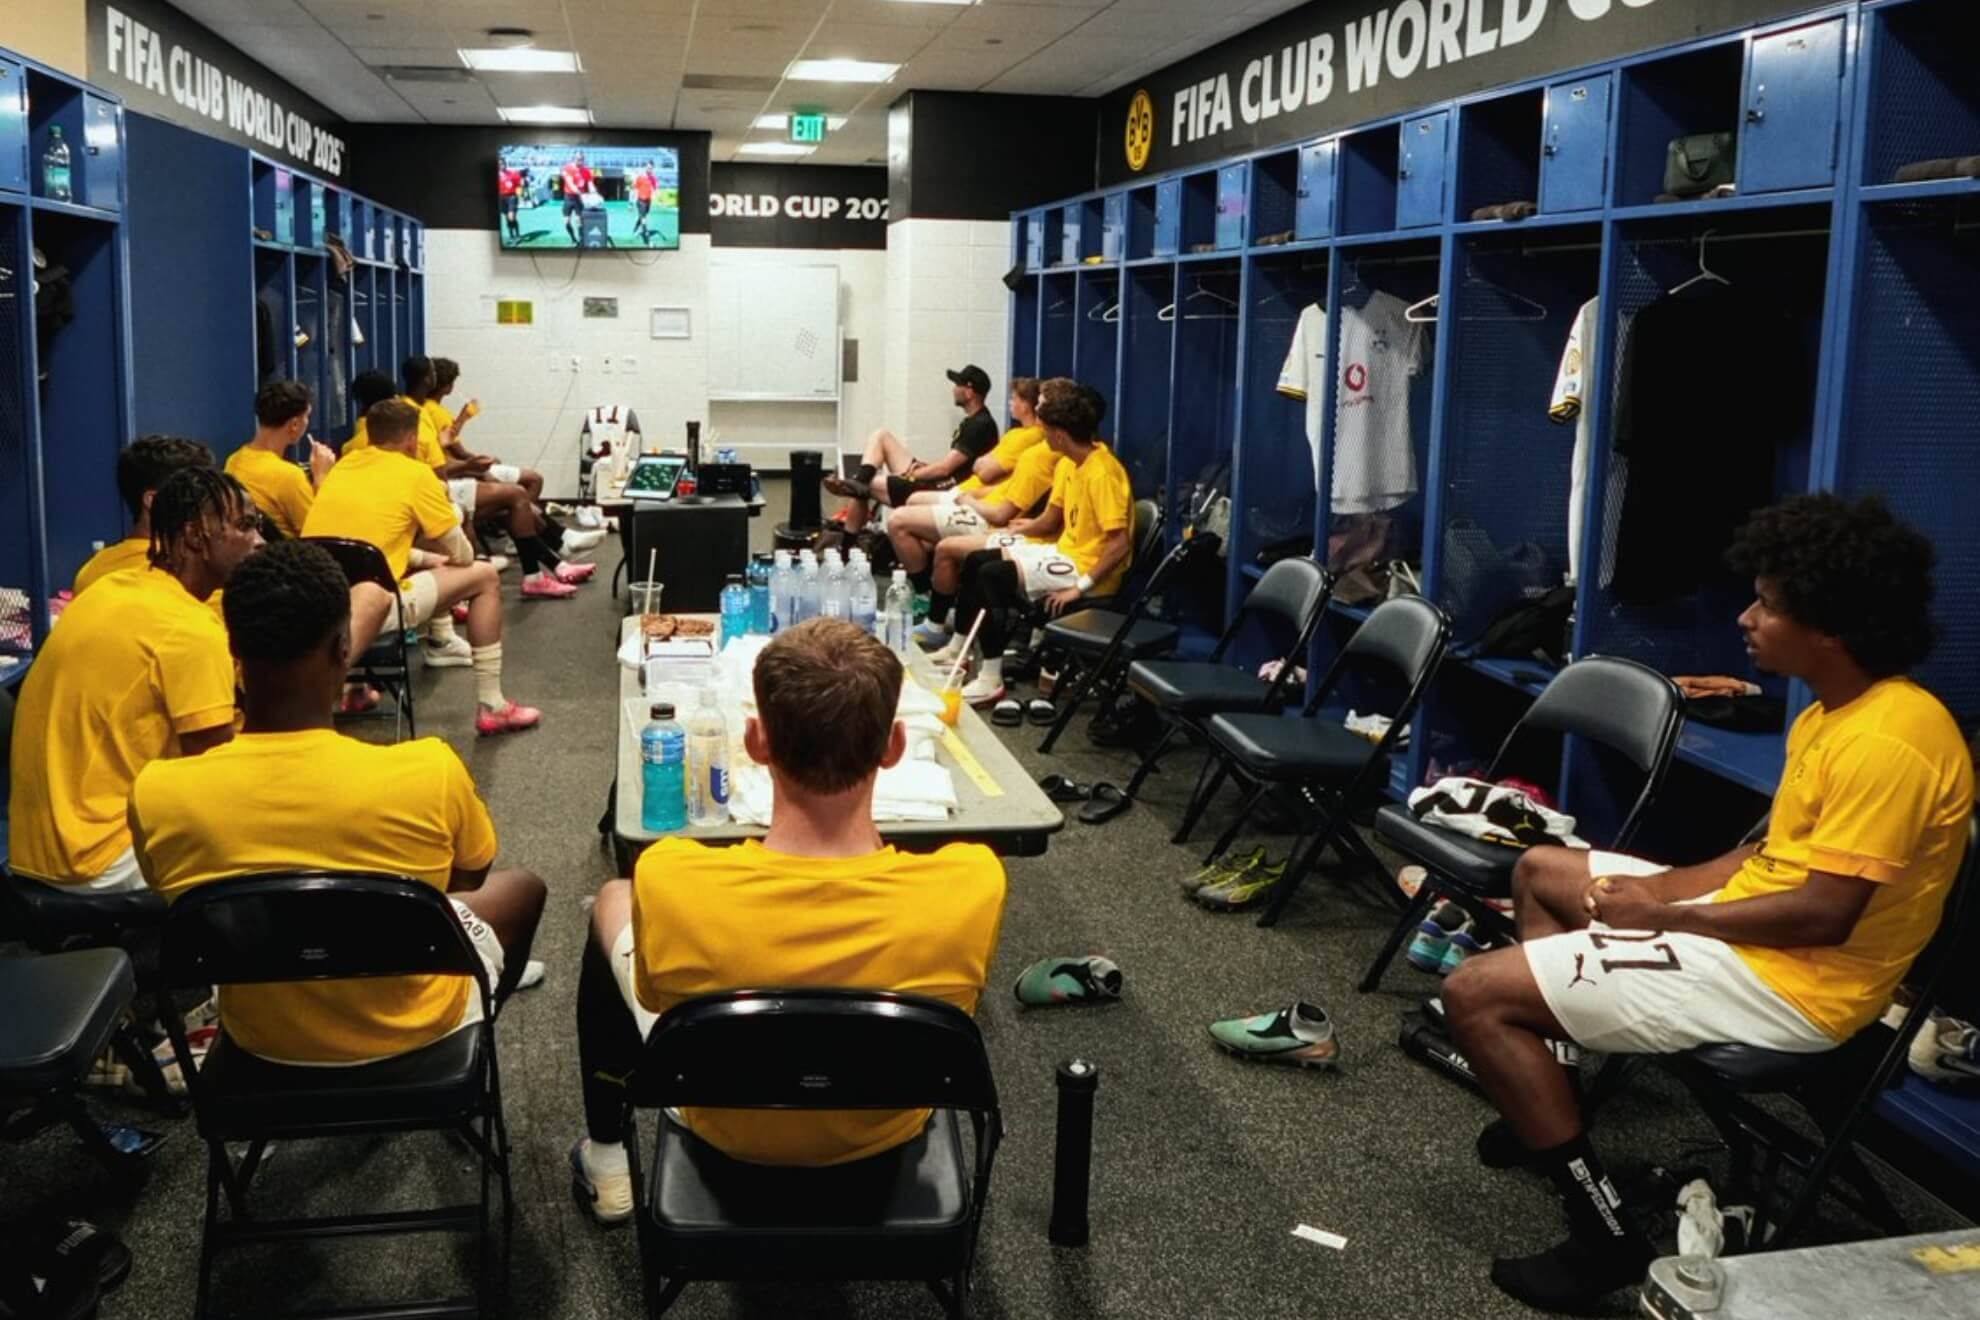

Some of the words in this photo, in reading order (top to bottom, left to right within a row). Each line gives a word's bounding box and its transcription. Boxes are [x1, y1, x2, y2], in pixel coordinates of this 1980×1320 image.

[106, 5, 167, 96] FIFA
[169, 45, 224, 121] CLUB
[226, 74, 285, 149] WORLD
[286, 111, 313, 162] CUP
[1171, 73, 1233, 147] FIFA
[1239, 32, 1334, 125] CLUB
[1345, 0, 1547, 93] WORLD
[793, 115, 825, 142] EXIT
[784, 195, 840, 219] CUP
